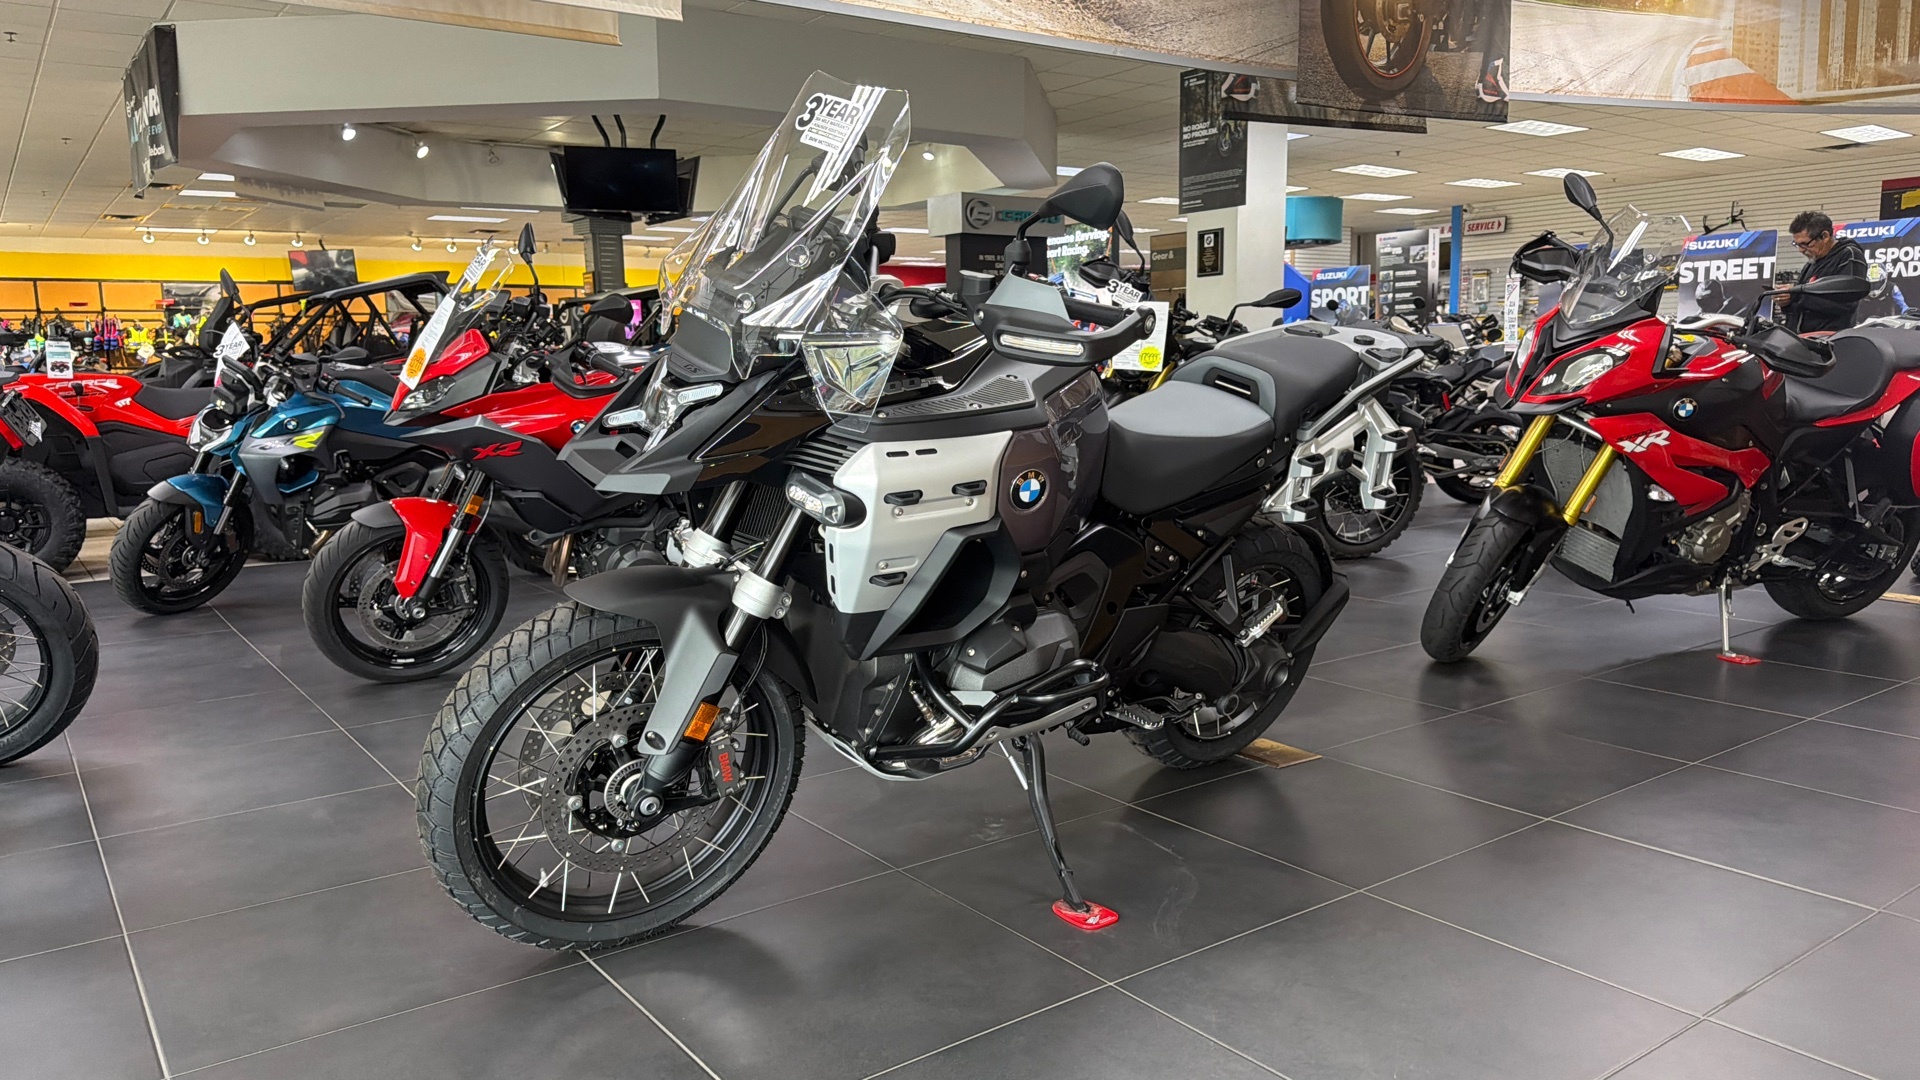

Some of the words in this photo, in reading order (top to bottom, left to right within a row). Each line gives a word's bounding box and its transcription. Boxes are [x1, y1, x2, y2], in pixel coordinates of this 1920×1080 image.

[798, 95, 823, 128] 3
[819, 98, 860, 125] YEAR
[1183, 125, 1191, 133] NO
[1192, 121, 1210, 131] ROAD?
[1192, 127, 1218, 138] PROBLEM.
[1467, 221, 1495, 232] SERVICE
[1836, 226, 1895, 239] SUZUKI
[1688, 238, 1739, 250] SUZUKI
[1152, 252, 1168, 260] Gear
[1679, 256, 1776, 284] STREET
[1886, 263, 1895, 272] &
[1315, 271, 1348, 280] SUZUKI
[1107, 281, 1119, 293] 3
[1119, 284, 1141, 299] YEAR
[1310, 286, 1370, 308] SPORT
[215, 344, 225, 356] 3
[226, 341, 243, 350] YEAR
[1616, 430, 1671, 453] XR
[1016, 471, 1045, 486] BMW
[718, 752, 734, 783] BMW
